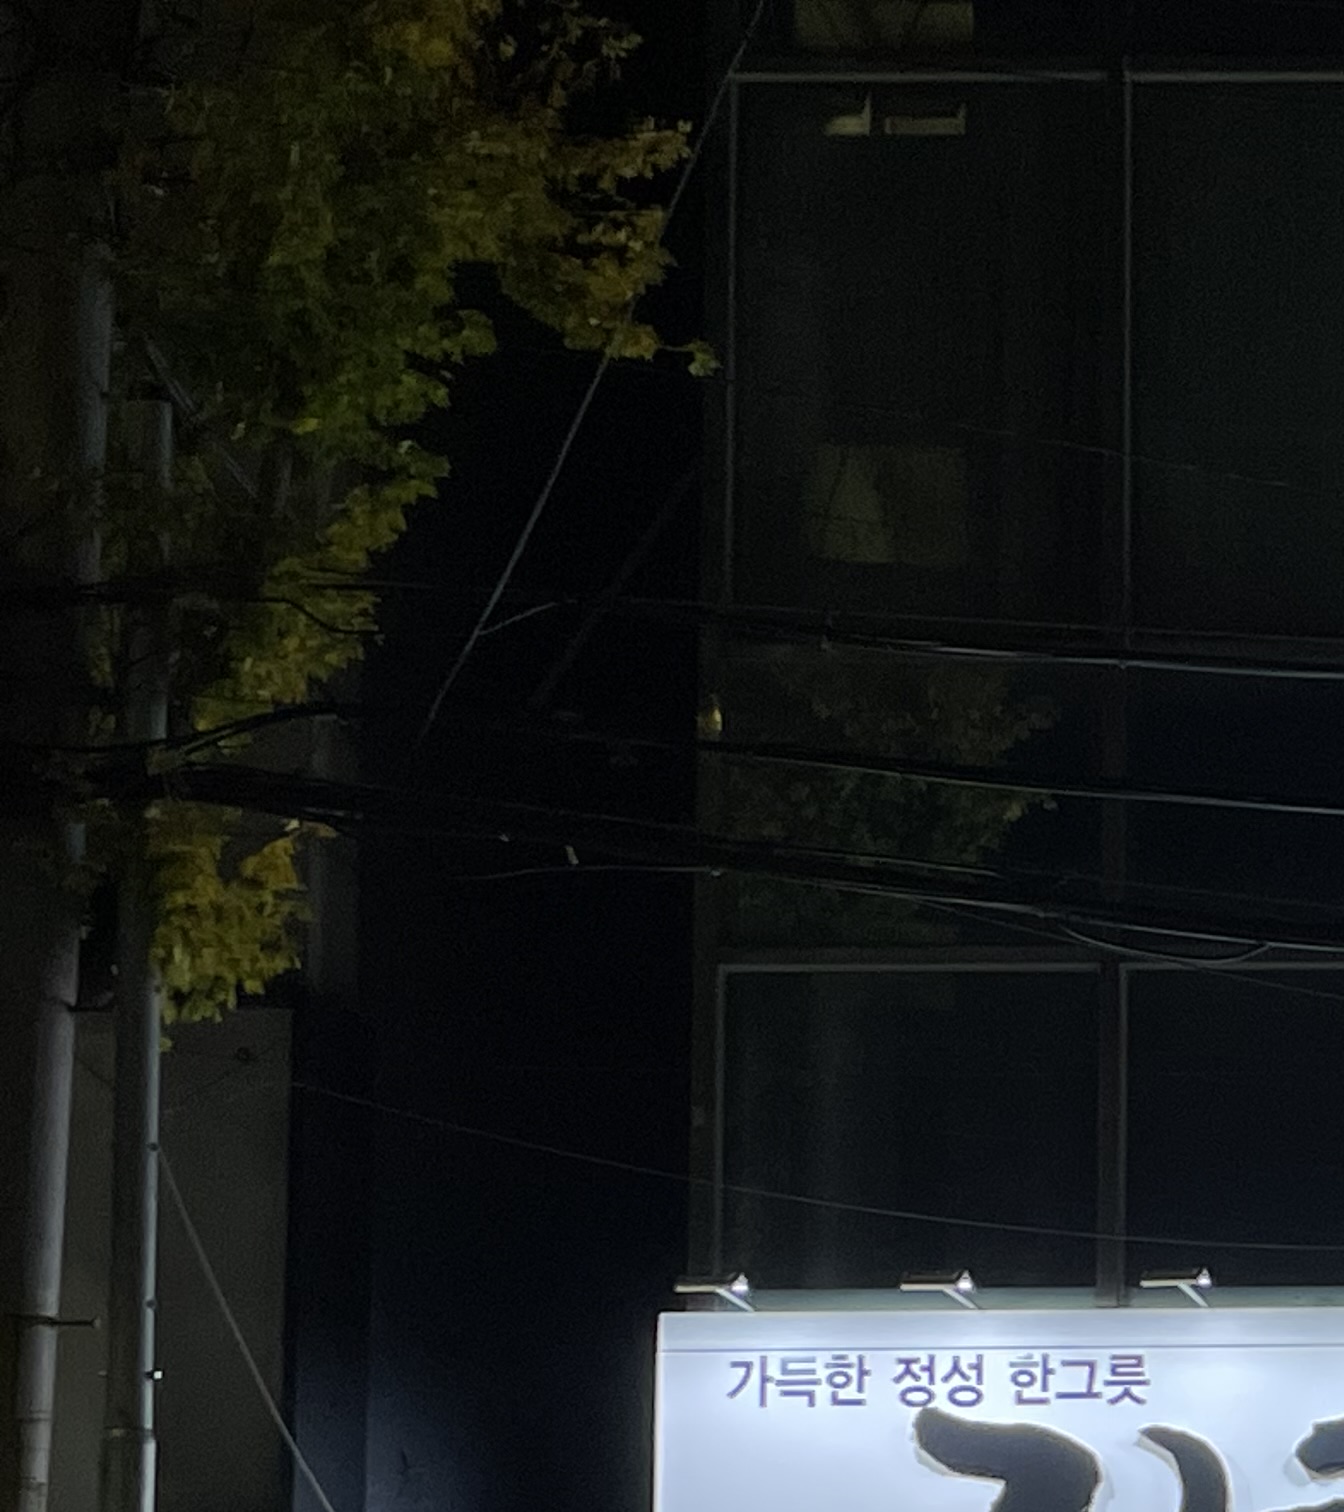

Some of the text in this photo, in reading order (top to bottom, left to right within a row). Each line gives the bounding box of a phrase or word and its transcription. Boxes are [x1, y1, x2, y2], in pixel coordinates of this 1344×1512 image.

[726, 1352, 1150, 1408] 가득한 정성 한그릇
